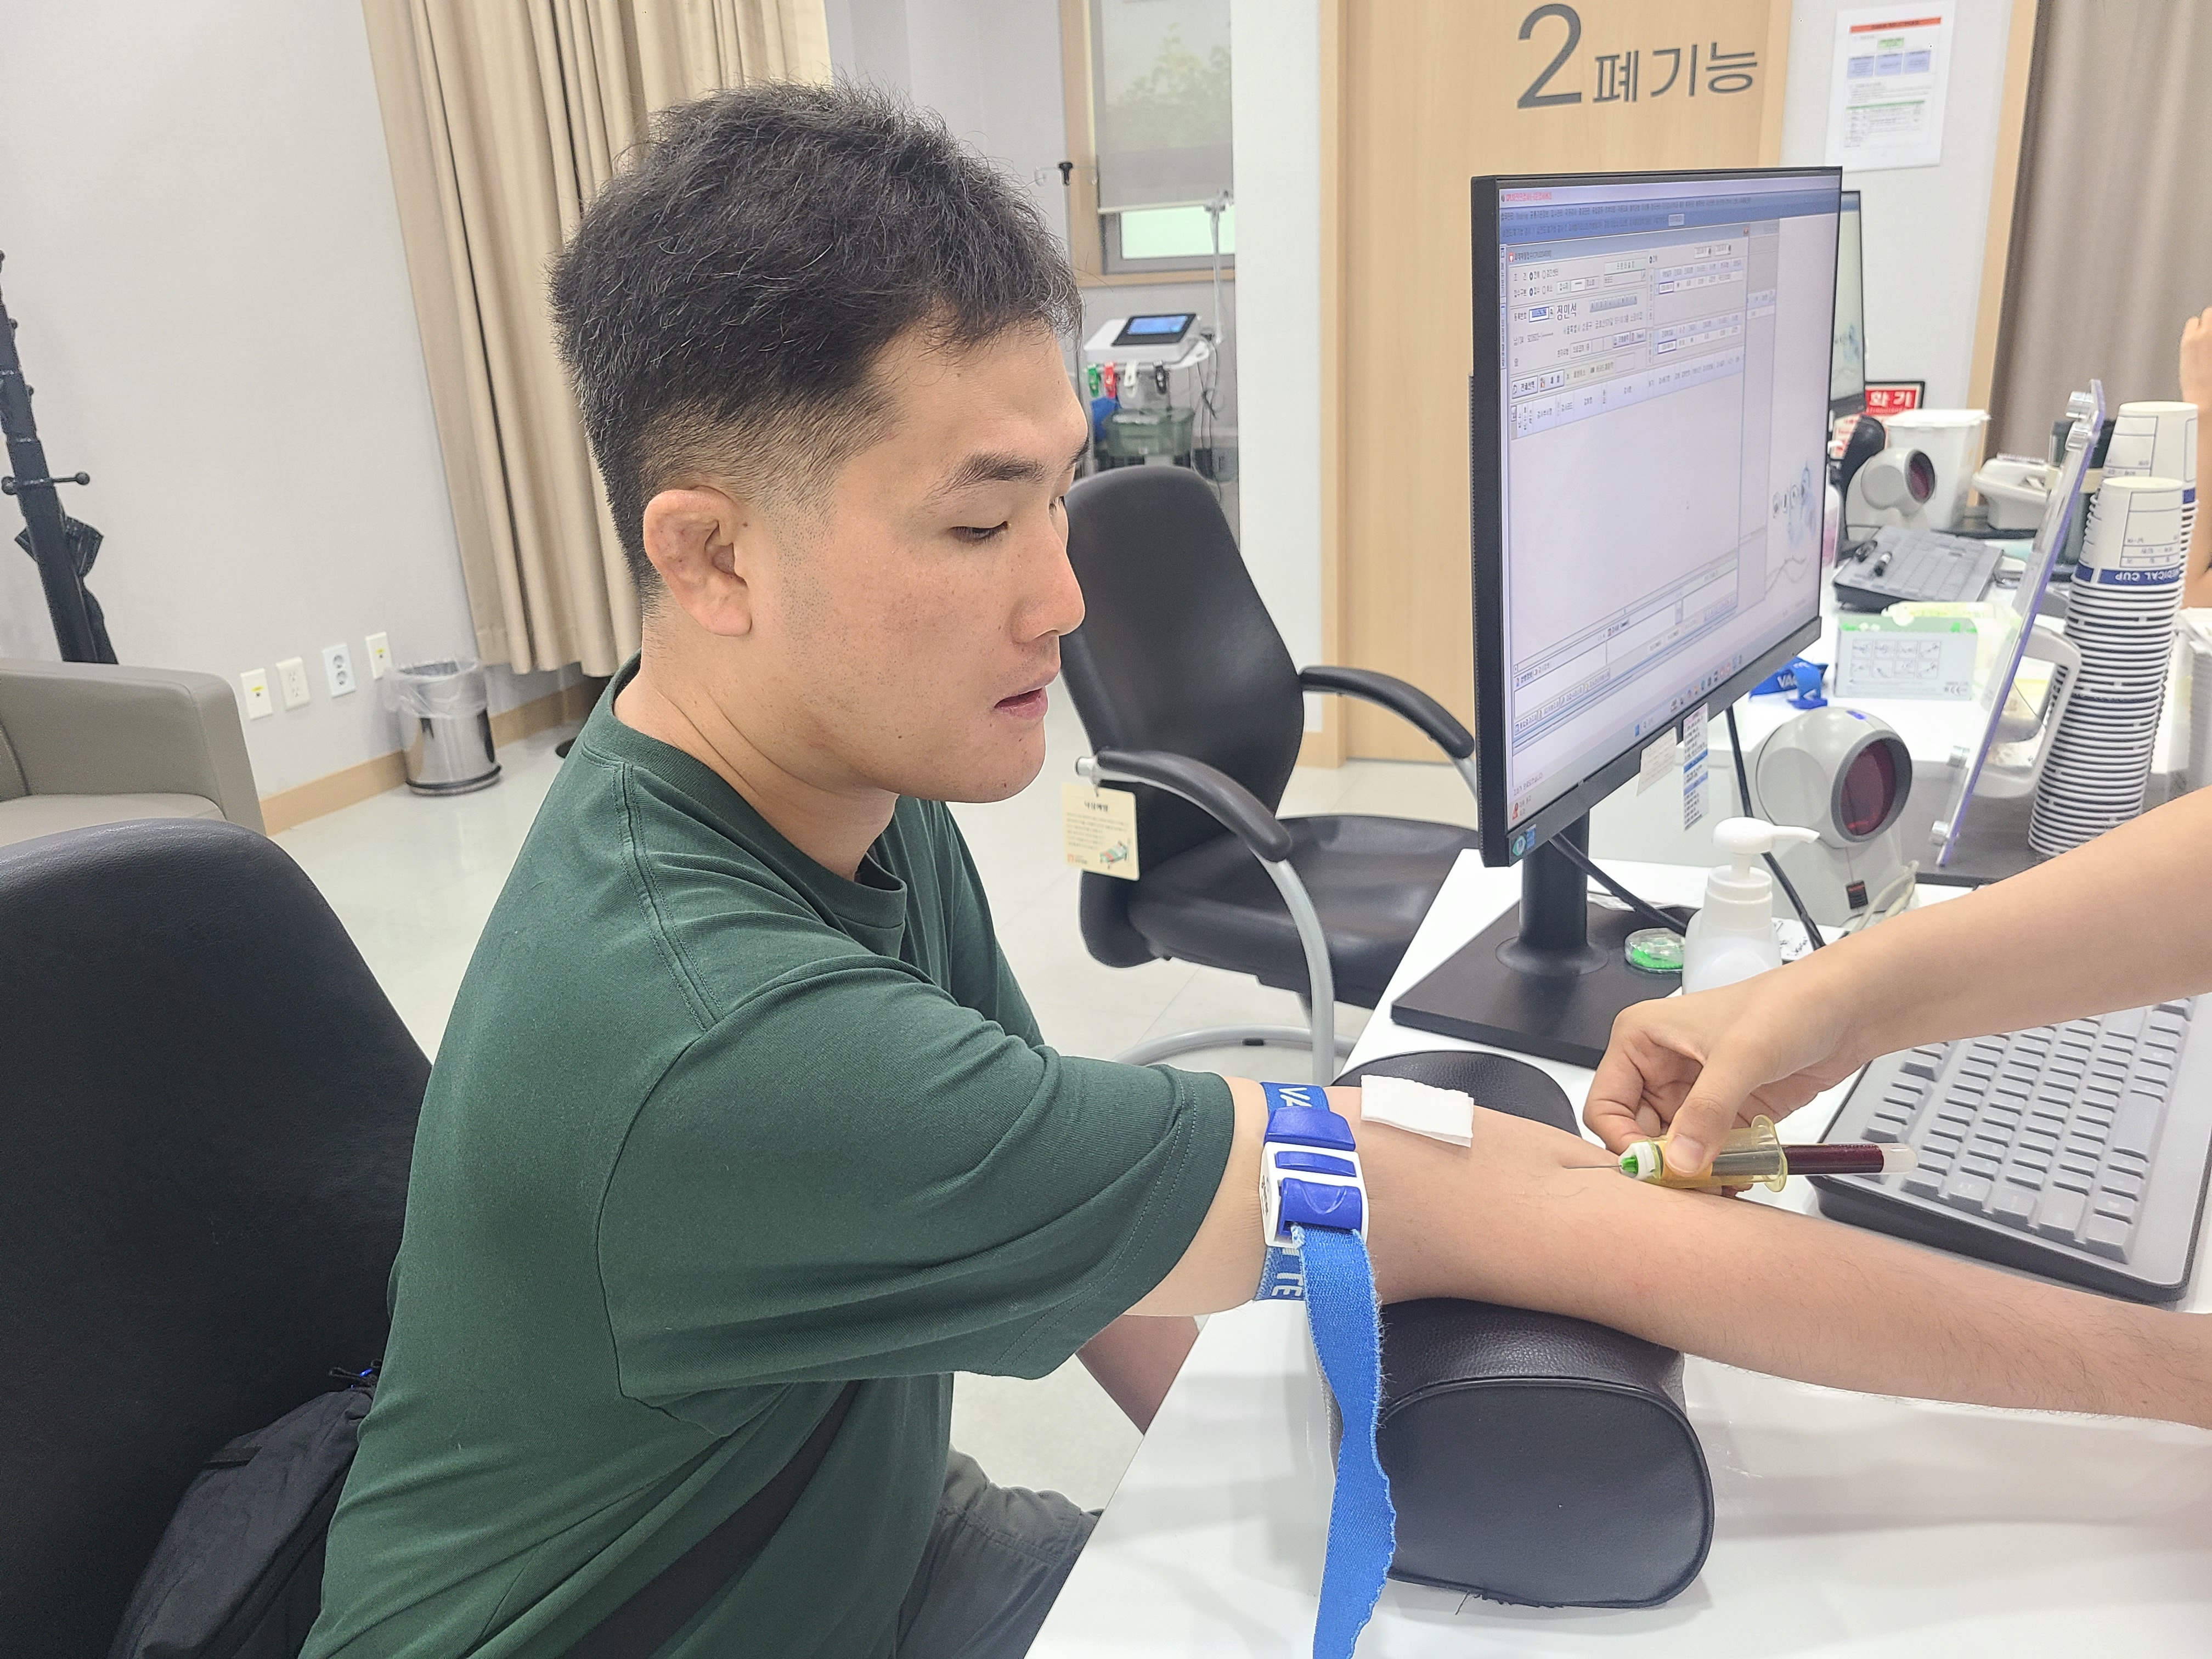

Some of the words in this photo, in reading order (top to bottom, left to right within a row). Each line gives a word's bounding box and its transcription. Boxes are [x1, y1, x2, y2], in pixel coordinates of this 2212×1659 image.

[1517, 3, 1582, 109] 2
[1593, 42, 1757, 103] 폐기능
[1556, 303, 1577, 321] 정민석
[2114, 572, 2140, 582] CUP
